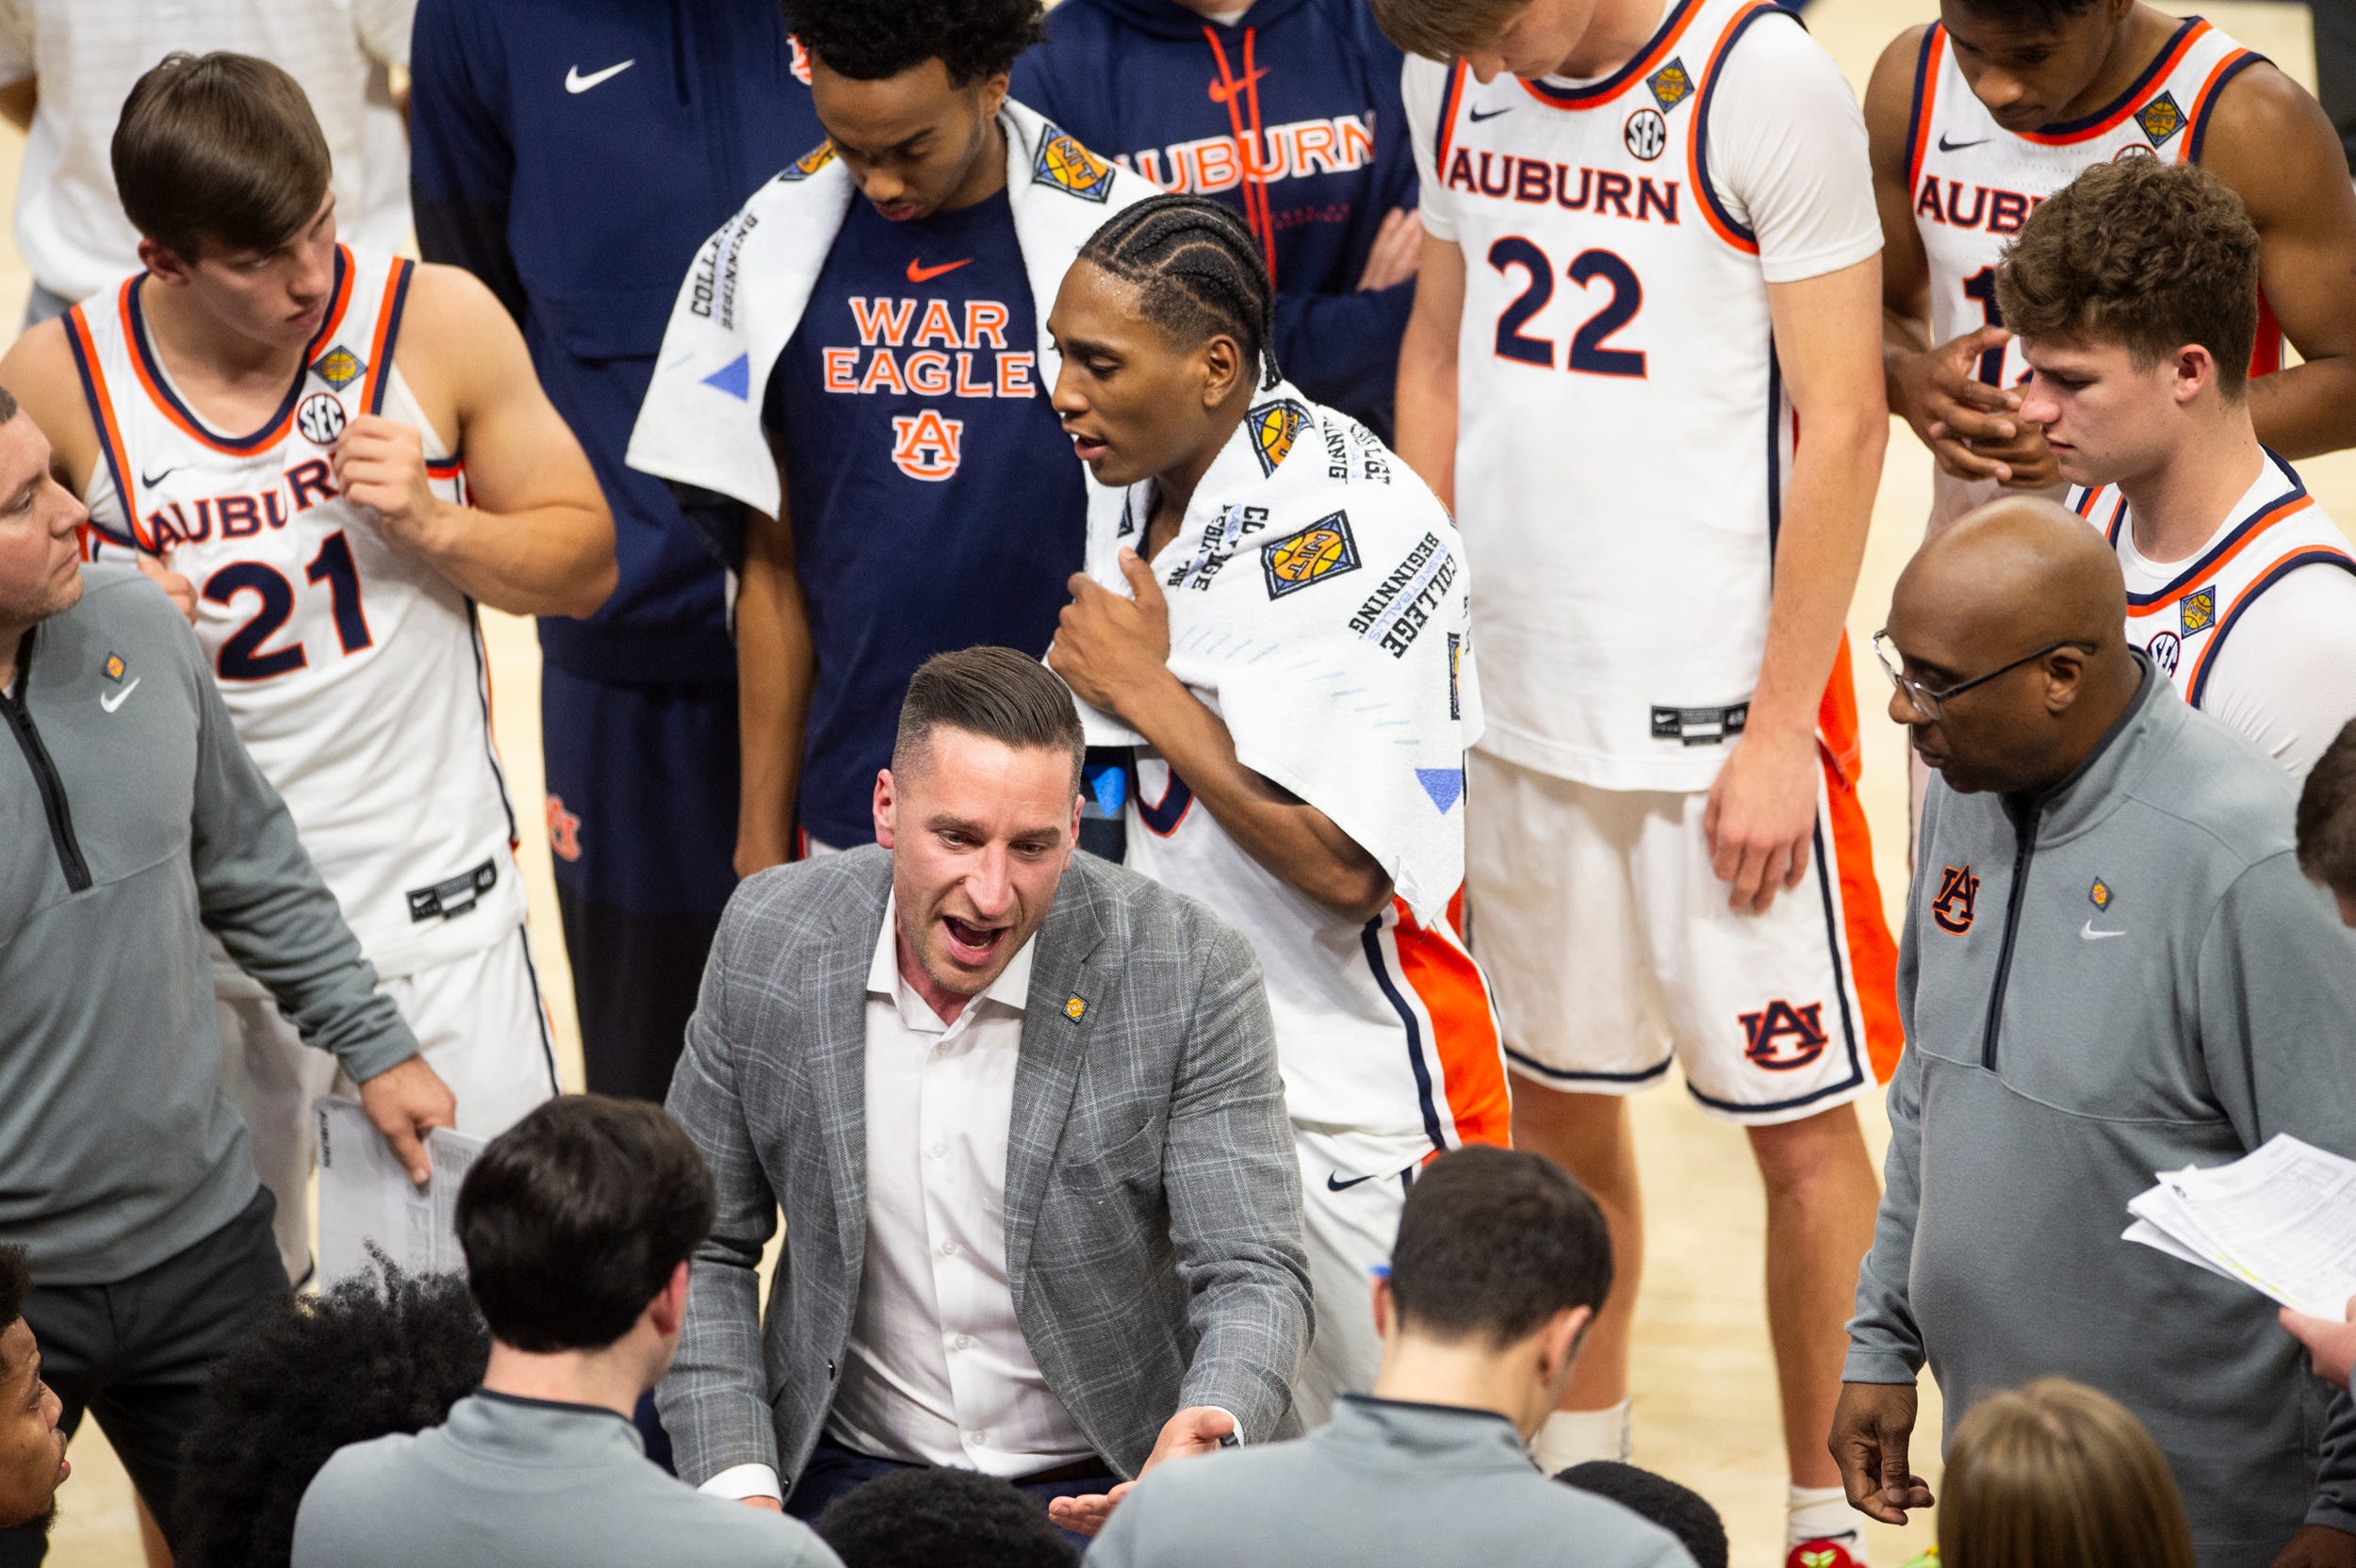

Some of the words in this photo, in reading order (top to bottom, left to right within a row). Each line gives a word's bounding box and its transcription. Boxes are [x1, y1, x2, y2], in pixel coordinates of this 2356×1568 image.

[1115, 110, 1376, 195] UBURN
[1626, 109, 1665, 158] SEC
[2148, 112, 2176, 124] NIT
[1055, 139, 1097, 180] NIT
[1448, 147, 1680, 225] AUBURN
[1916, 174, 2045, 236] AUB
[848, 297, 1009, 349] WAR
[1487, 235, 1648, 379] 22
[823, 346, 1036, 398] EAGLE
[298, 393, 346, 444] SEC
[892, 409, 963, 482] AU
[146, 452, 343, 556] AUBUR
[1287, 533, 1332, 580] NIT
[1348, 531, 1439, 634] BEGINNING
[201, 529, 373, 681] 21
[1380, 553, 1458, 660] COLLEGE
[1931, 863, 1981, 936] AU
[1738, 1000, 1828, 1072] AU
